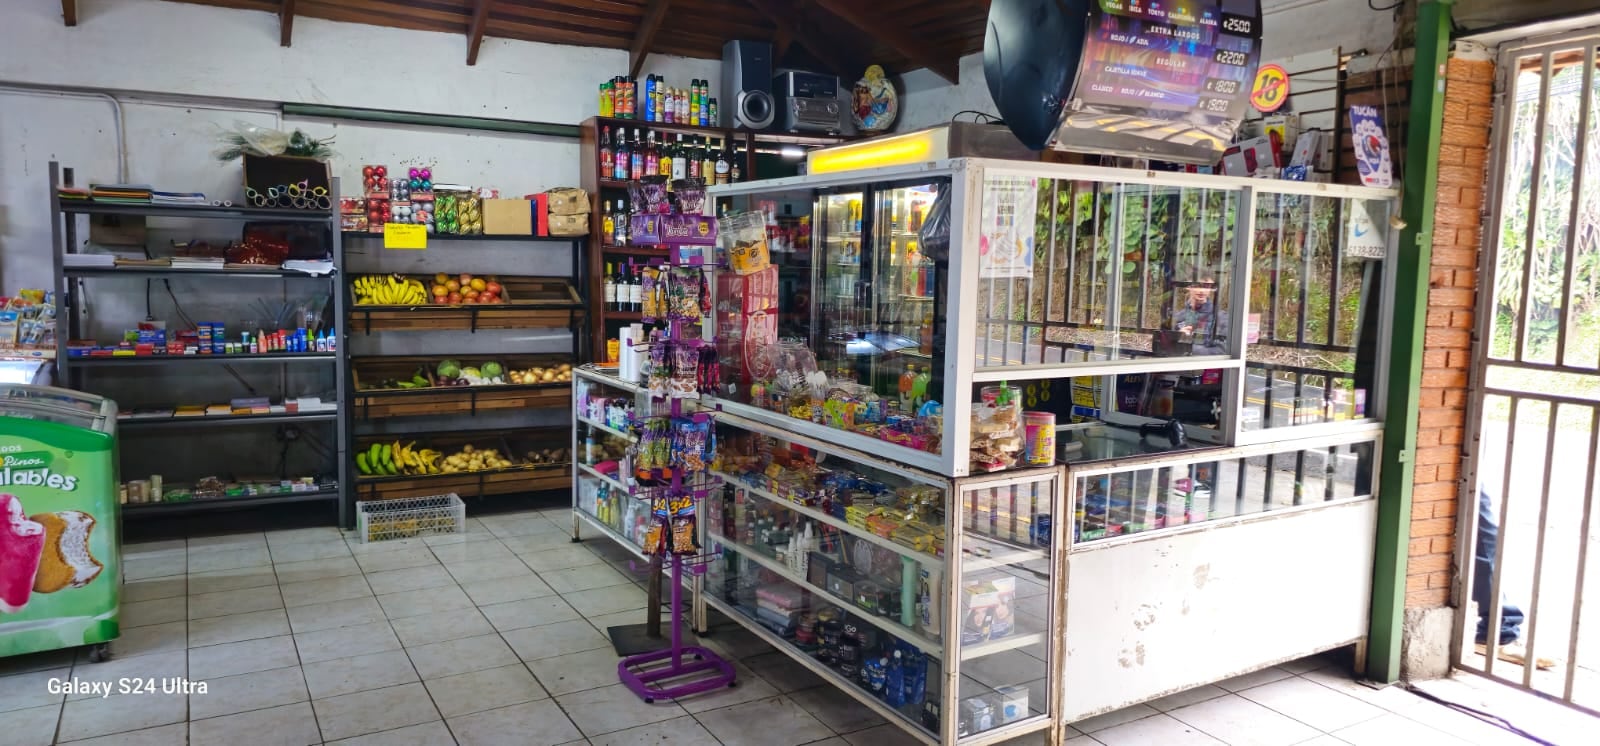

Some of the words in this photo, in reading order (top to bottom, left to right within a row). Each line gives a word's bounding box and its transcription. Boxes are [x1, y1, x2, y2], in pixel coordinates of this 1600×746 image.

[1150, 25, 1172, 35] EXTRA
[1173, 30, 1200, 40] LARGOS
[1156, 57, 1187, 68] REGULAR
[4, 456, 45, 467] Pinos
[0, 467, 77, 491] lables
[669, 495, 693, 515] 3x2
